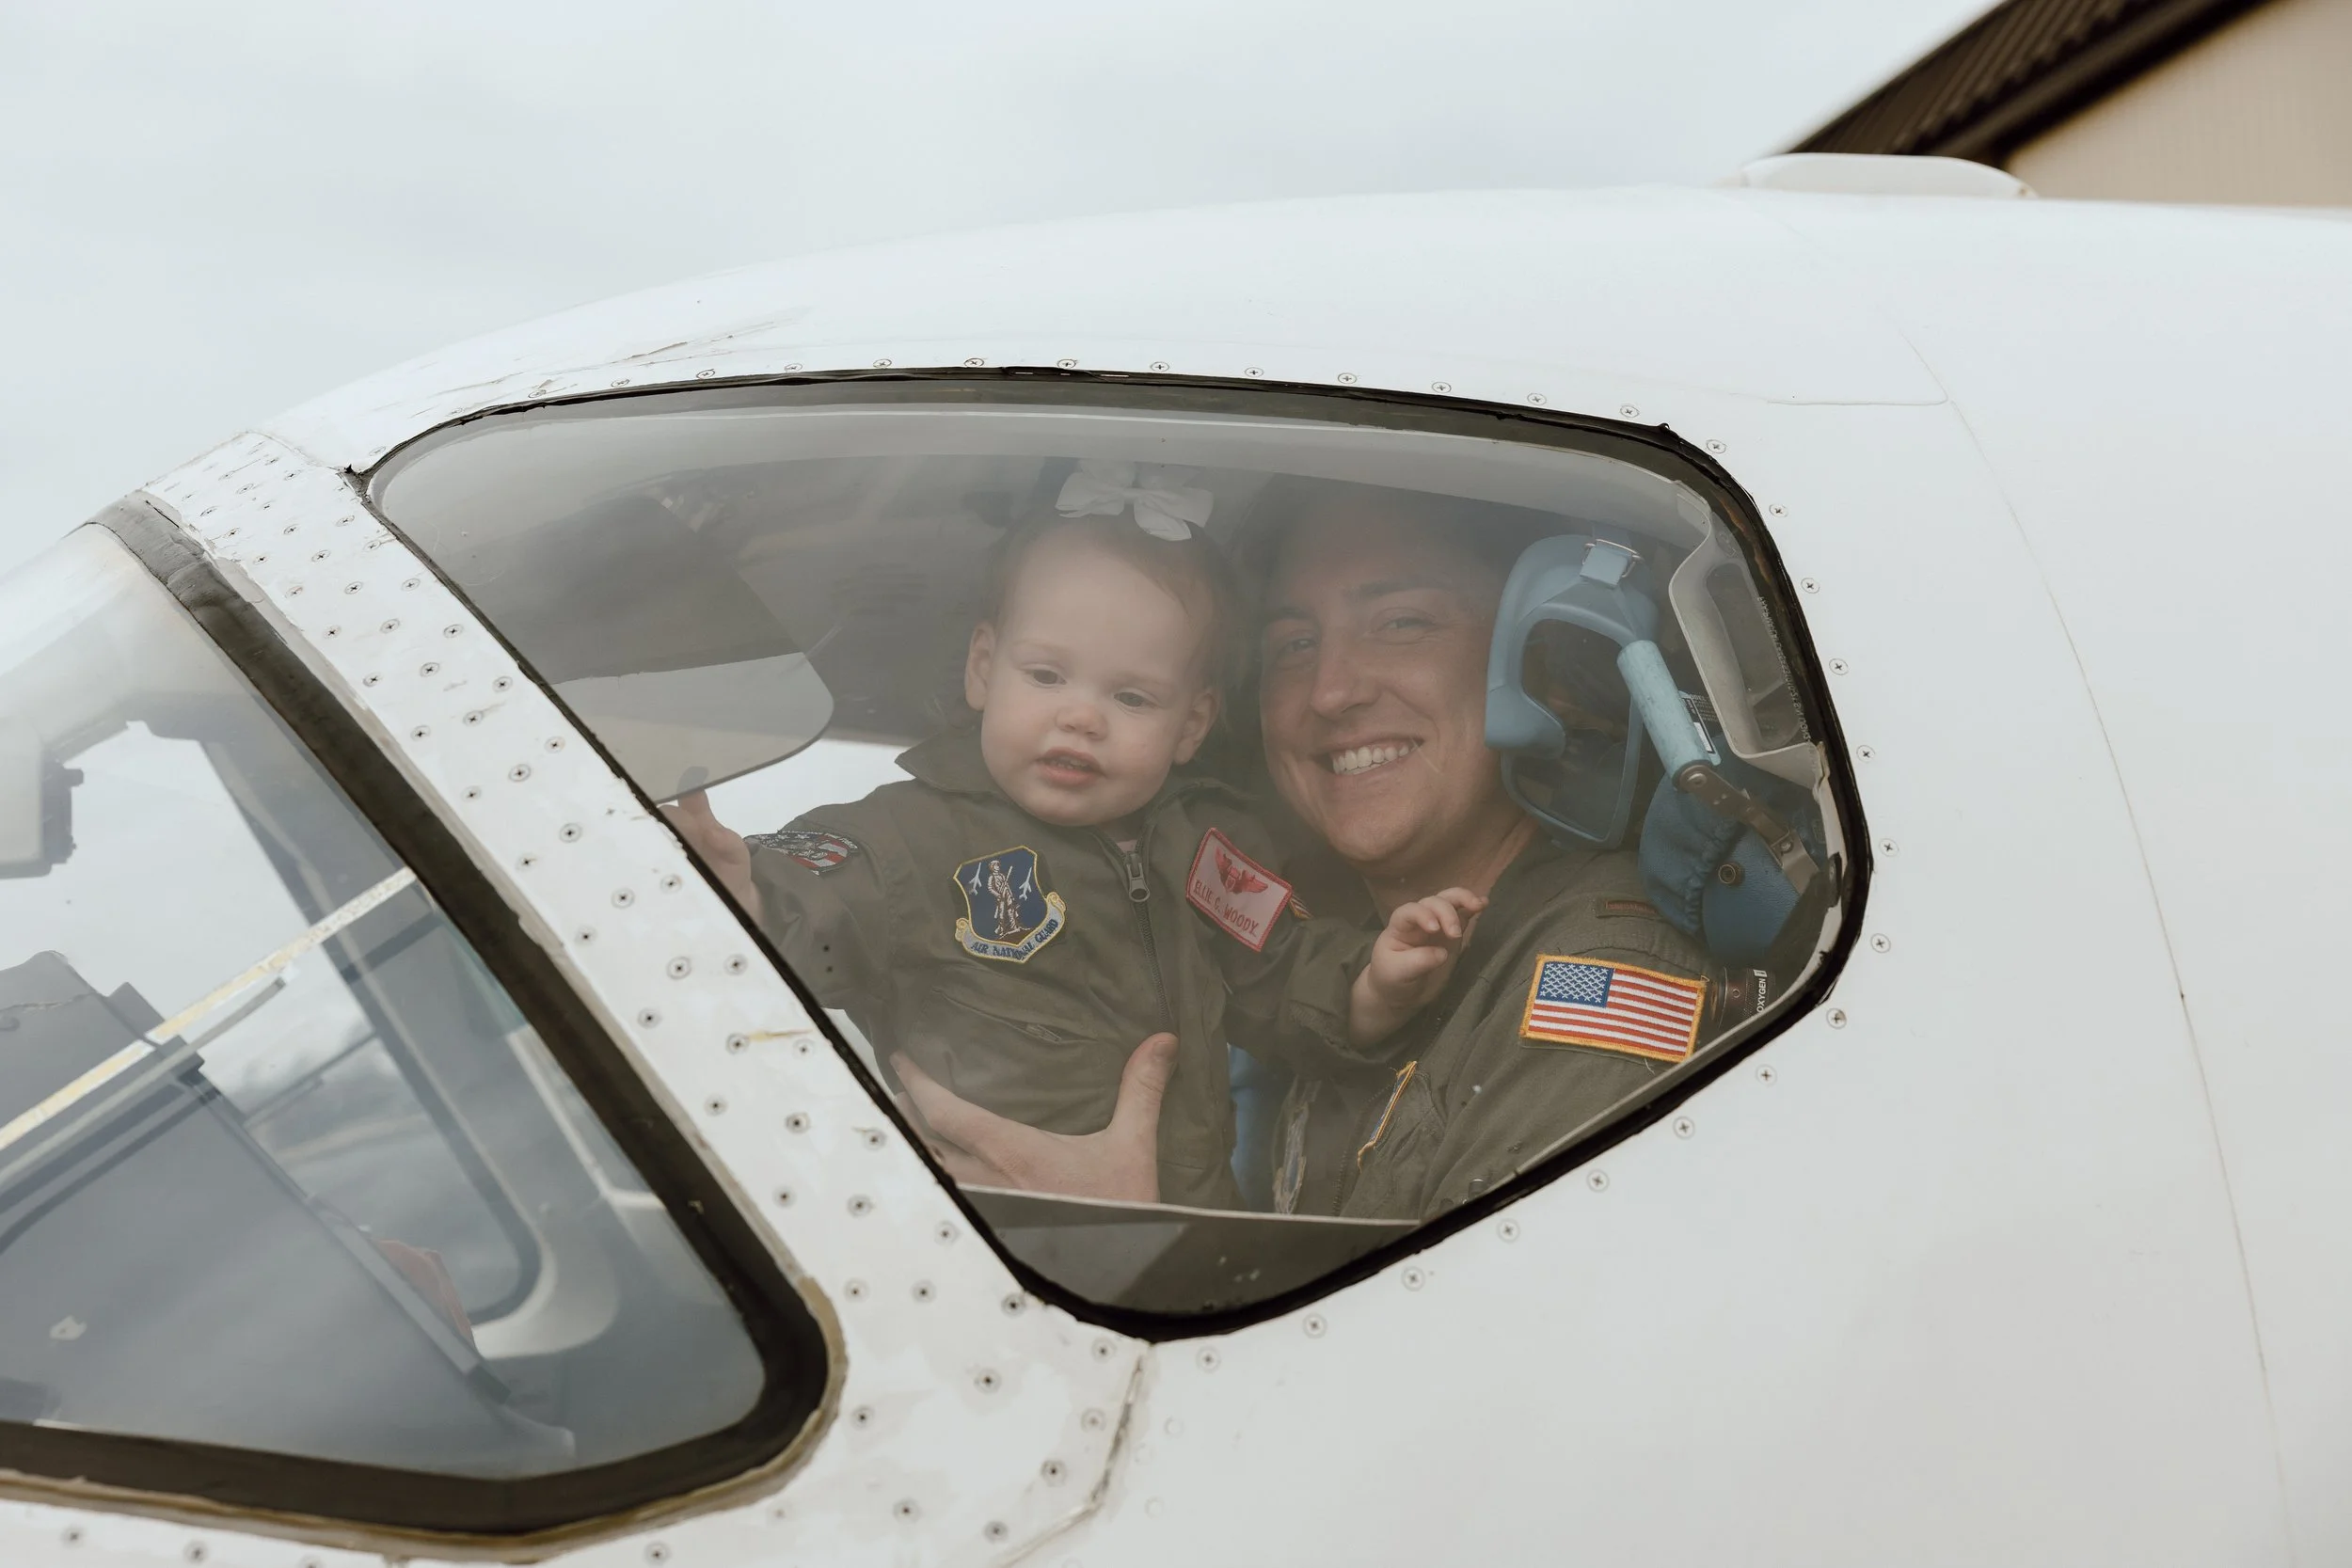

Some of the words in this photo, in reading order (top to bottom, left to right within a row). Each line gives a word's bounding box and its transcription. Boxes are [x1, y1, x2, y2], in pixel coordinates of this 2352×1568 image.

[1223, 903, 1259, 937] WOODY
[971, 942, 989, 954] AIR
[993, 942, 1034, 960] NATIONAL
[1035, 919, 1058, 943] GUARD
[1756, 977, 1767, 1013] OXYGEN
